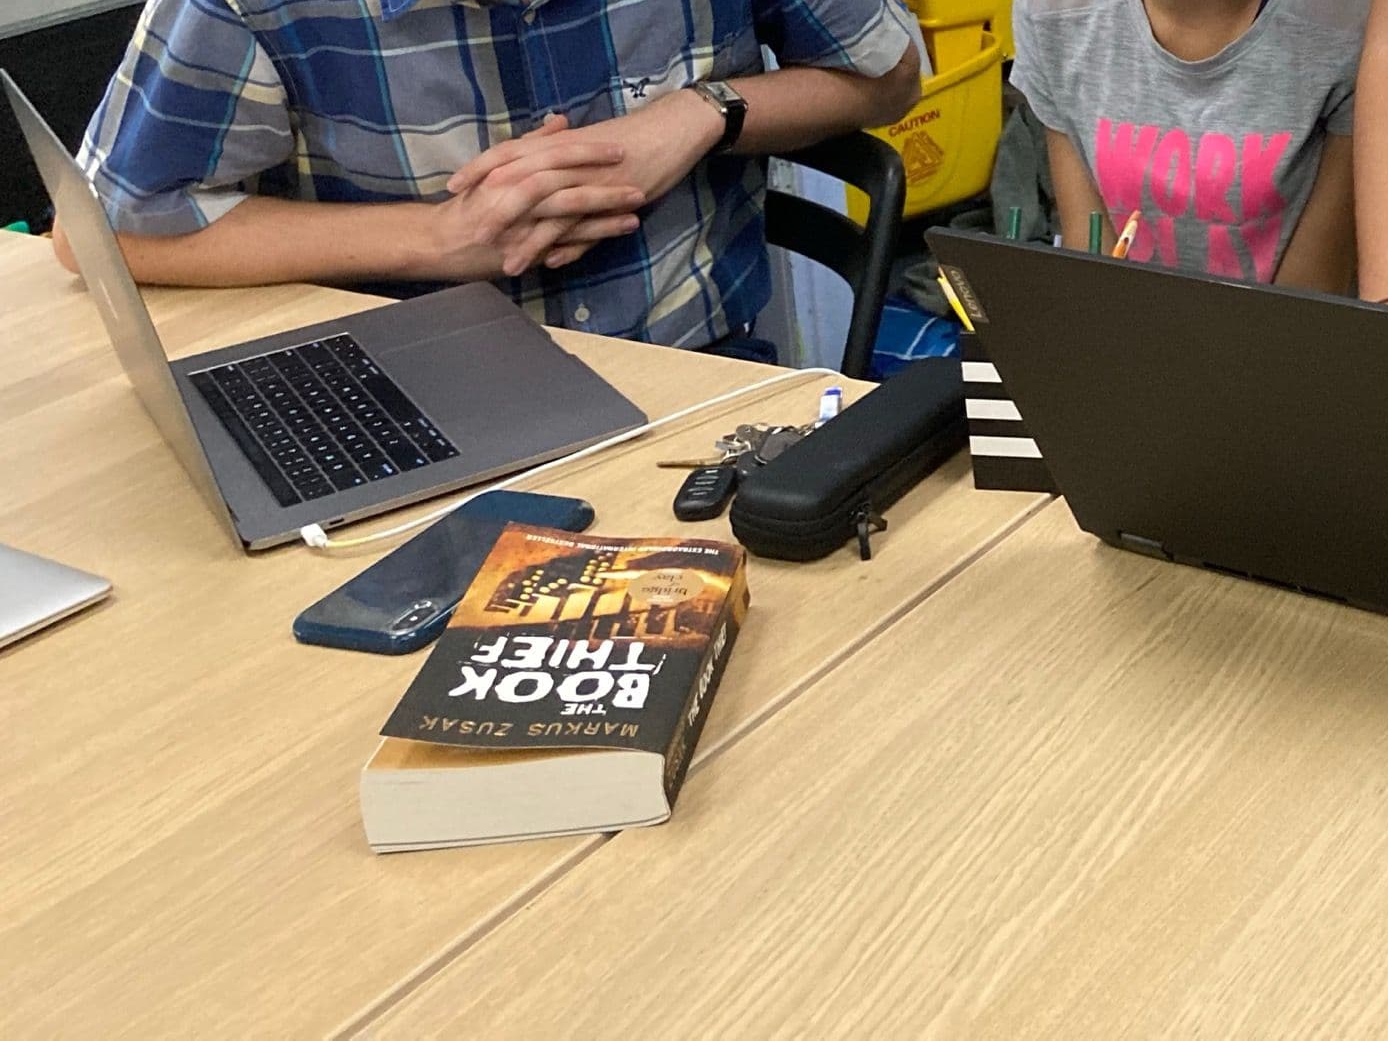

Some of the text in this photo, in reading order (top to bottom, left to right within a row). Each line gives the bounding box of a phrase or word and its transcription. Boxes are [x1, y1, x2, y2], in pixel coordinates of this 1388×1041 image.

[889, 109, 941, 137] CAUTION
[1095, 118, 1292, 223] WORK
[470, 635, 656, 671] THIEF
[448, 666, 650, 709] BOOK
[560, 703, 607, 716] THE
[419, 715, 640, 738] MARKUS ZUSAK
